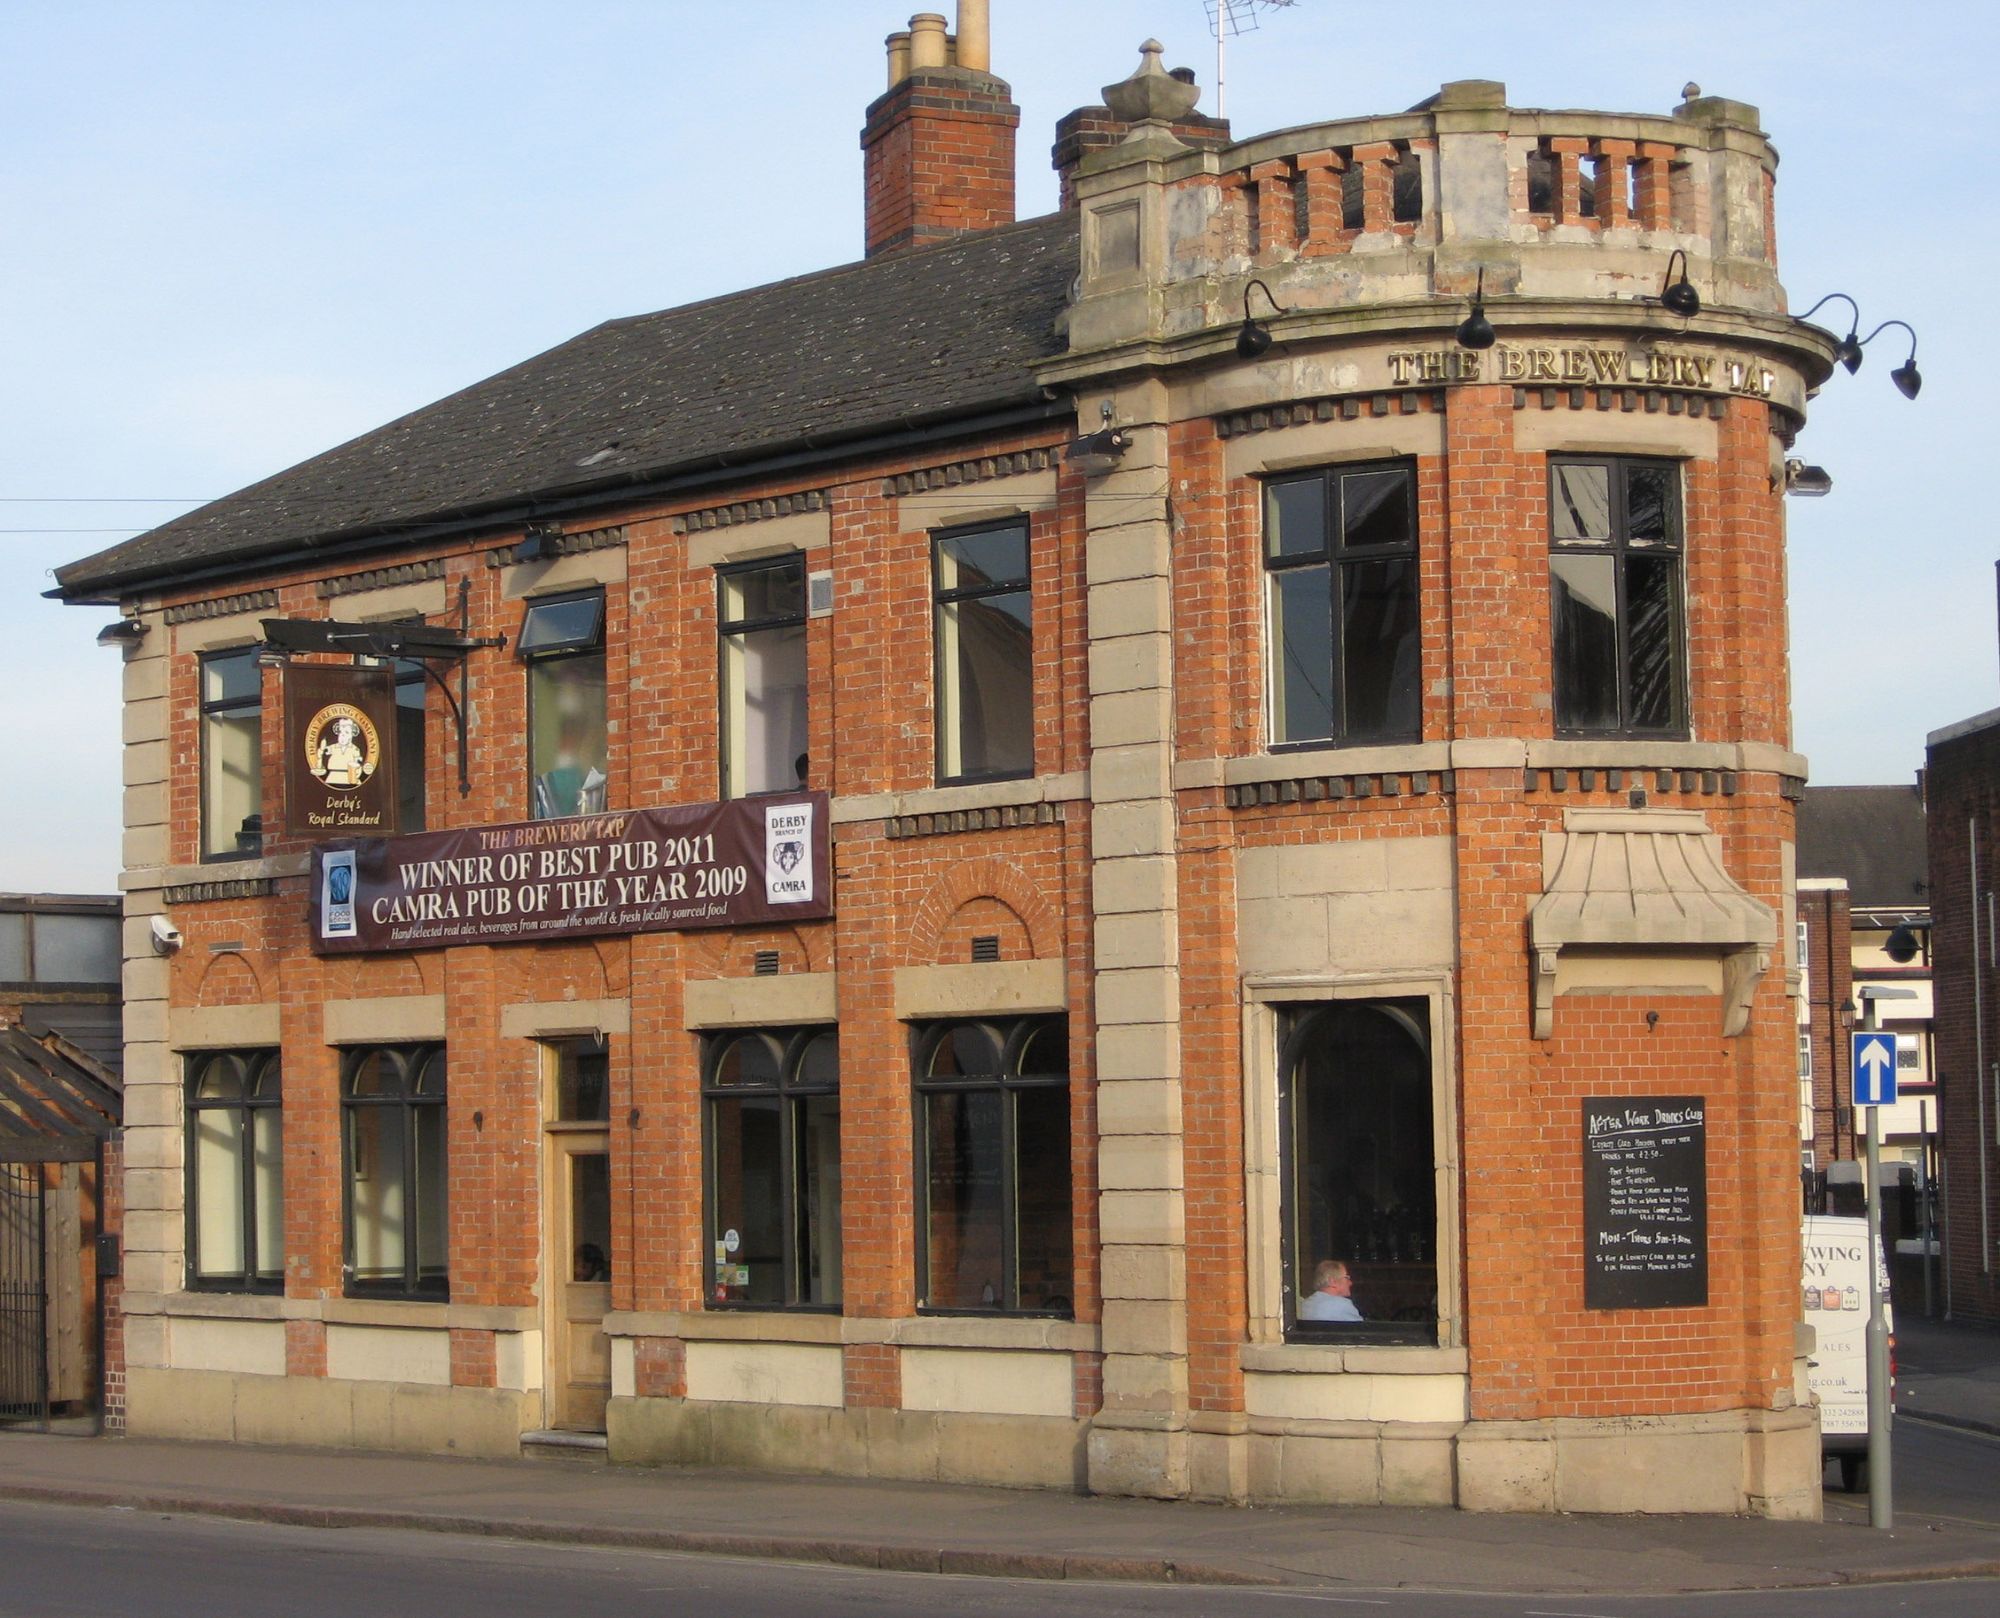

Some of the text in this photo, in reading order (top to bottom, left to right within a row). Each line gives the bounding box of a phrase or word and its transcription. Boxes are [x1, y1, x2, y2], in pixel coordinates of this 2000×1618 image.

[1388, 350, 1479, 385] THE
[1725, 360, 1775, 398] TAP
[308, 707, 376, 756] DERBY BREWING COMPANY
[326, 795, 362, 812] Derby's
[308, 810, 381, 828] Royal Standard
[771, 815, 807, 829] DERBY
[479, 815, 625, 850] THE BREWERY TAP
[399, 833, 716, 890] WINNER OF BEST PUB 2011
[372, 865, 747, 924] CAMRA PUB OF THE YEAR 2009
[772, 880, 807, 893] CAMRA
[444, 922, 460, 936] real
[461, 922, 478, 935] ales,
[480, 919, 518, 936] beverages
[517, 918, 538, 934] from
[540, 914, 569, 929] around
[584, 912, 608, 926] world
[608, 913, 617, 925] &
[618, 911, 641, 927] fresh
[642, 906, 671, 923] locally
[672, 903, 706, 919] sourced
[706, 901, 728, 919] food
[1590, 1114, 1622, 1134] AFTER
[1624, 1109, 1650, 1126] WORK
[1804, 1246, 1861, 1262] WING
[1823, 1343, 1851, 1351] ALES
